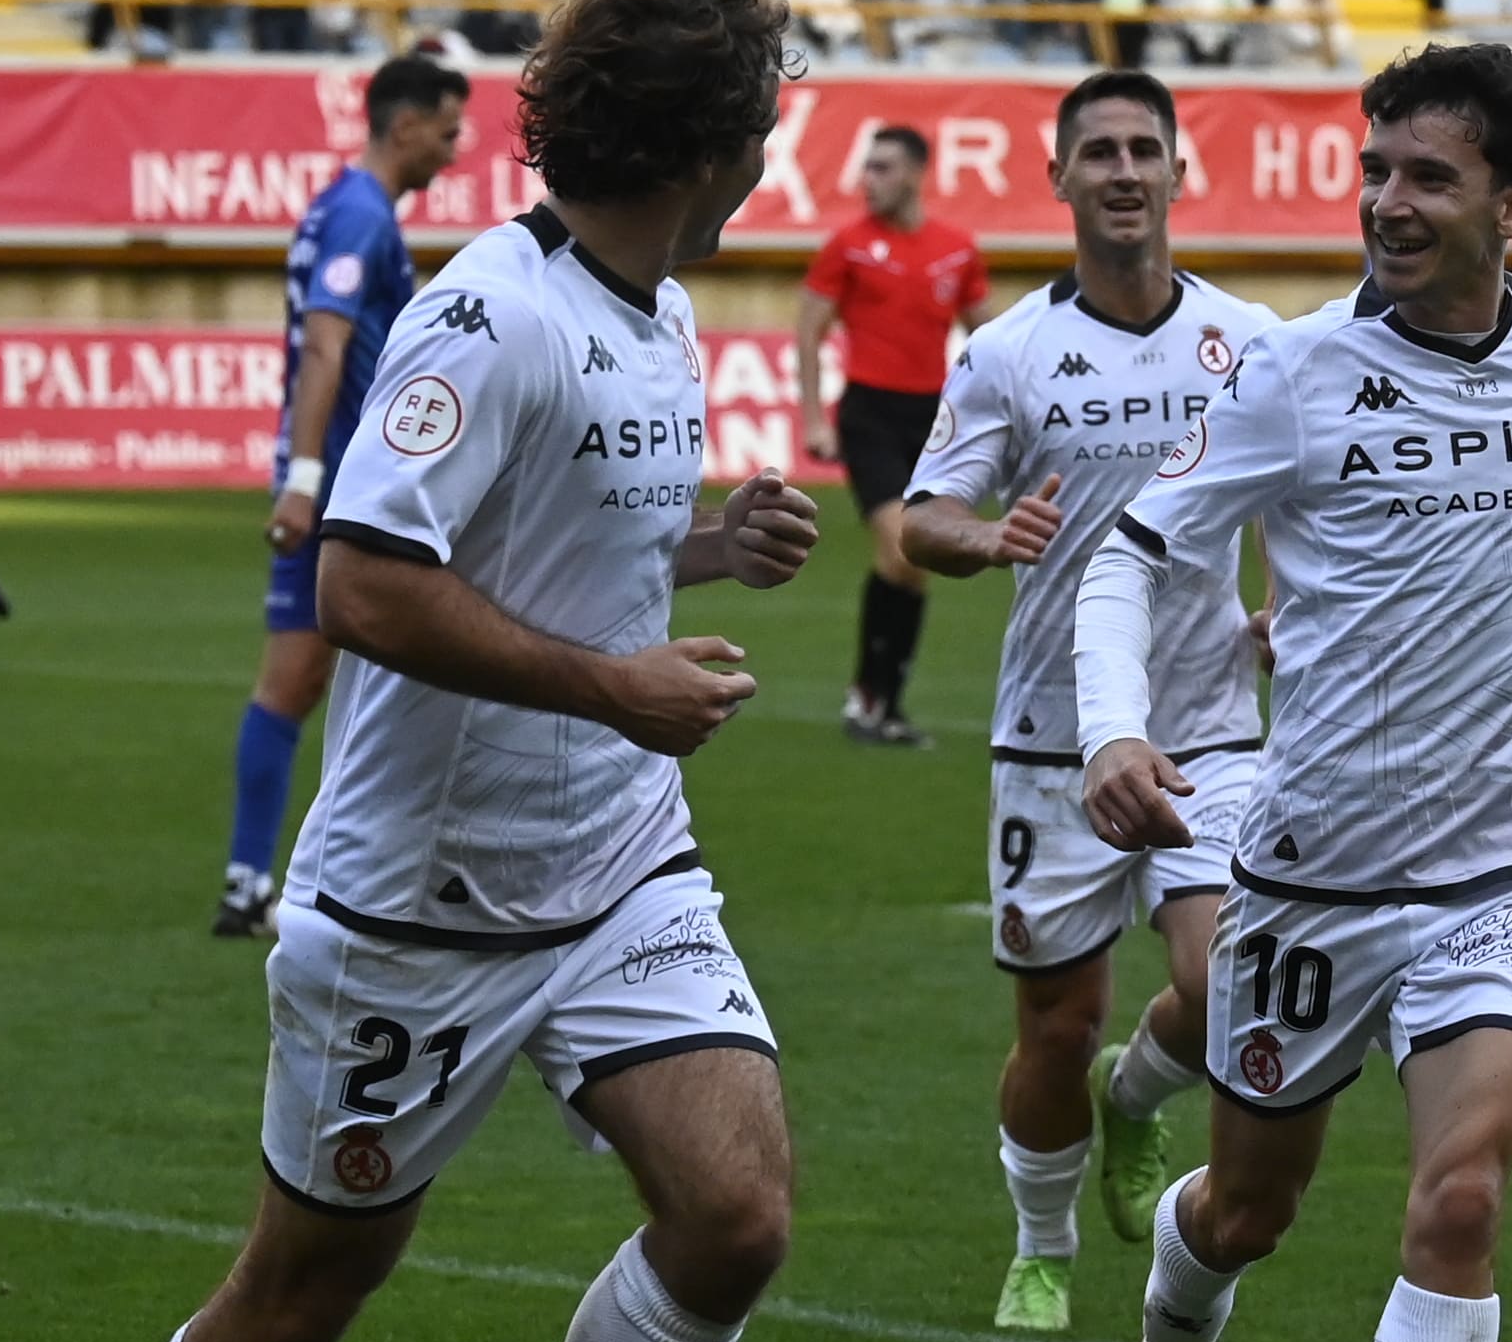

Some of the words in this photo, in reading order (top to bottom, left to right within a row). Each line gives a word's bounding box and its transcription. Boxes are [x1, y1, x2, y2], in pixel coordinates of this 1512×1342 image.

[1454, 379, 1501, 399] 1923
[999, 816, 1035, 890] 9
[1240, 932, 1333, 1033] 10
[338, 1015, 470, 1118] 21
